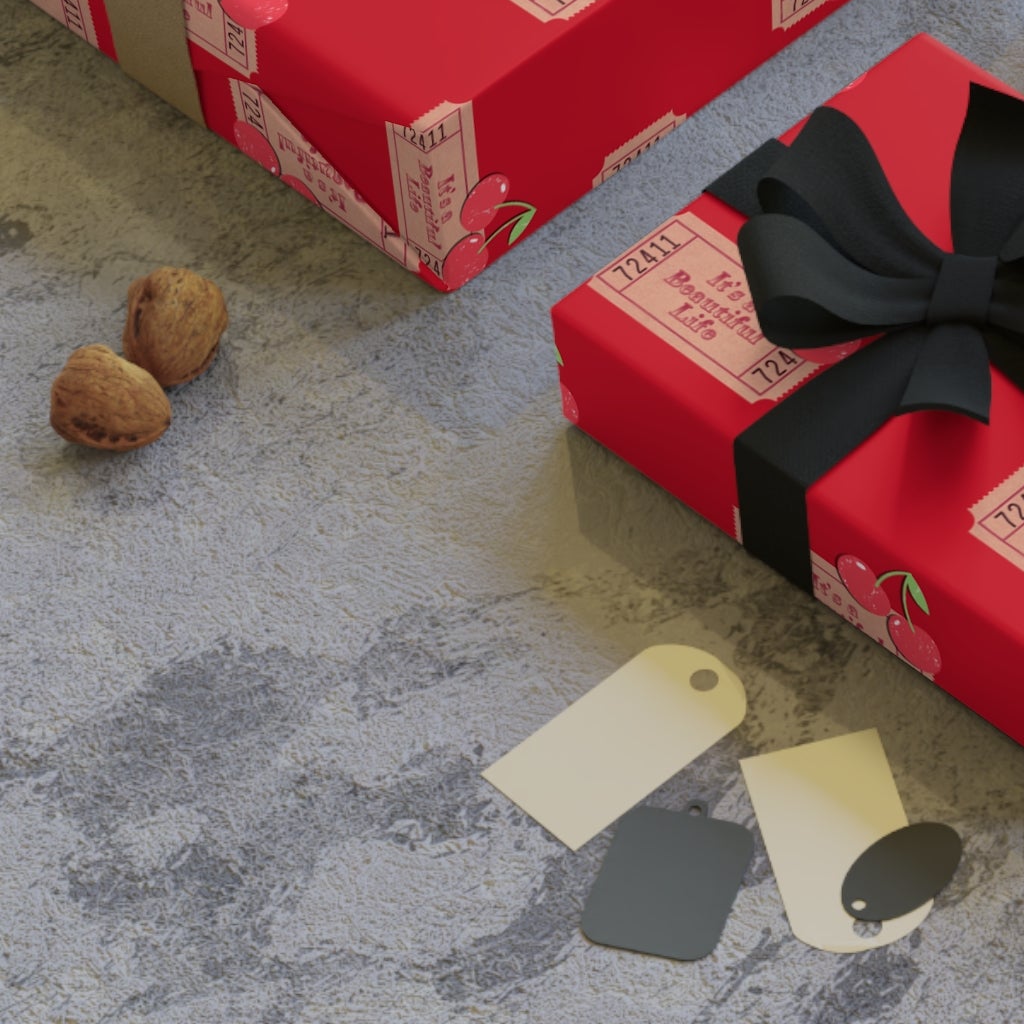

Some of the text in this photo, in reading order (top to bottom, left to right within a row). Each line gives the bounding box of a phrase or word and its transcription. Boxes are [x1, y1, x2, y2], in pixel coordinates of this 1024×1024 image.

[227, 21, 245, 56] 724
[406, 172, 422, 213] Life
[418, 159, 442, 251] Beautiful
[612, 234, 681, 281] 72411
[706, 271, 746, 302] It's
[663, 269, 764, 345] Beautiful
[668, 302, 717, 341] Life
[752, 350, 797, 384] 724
